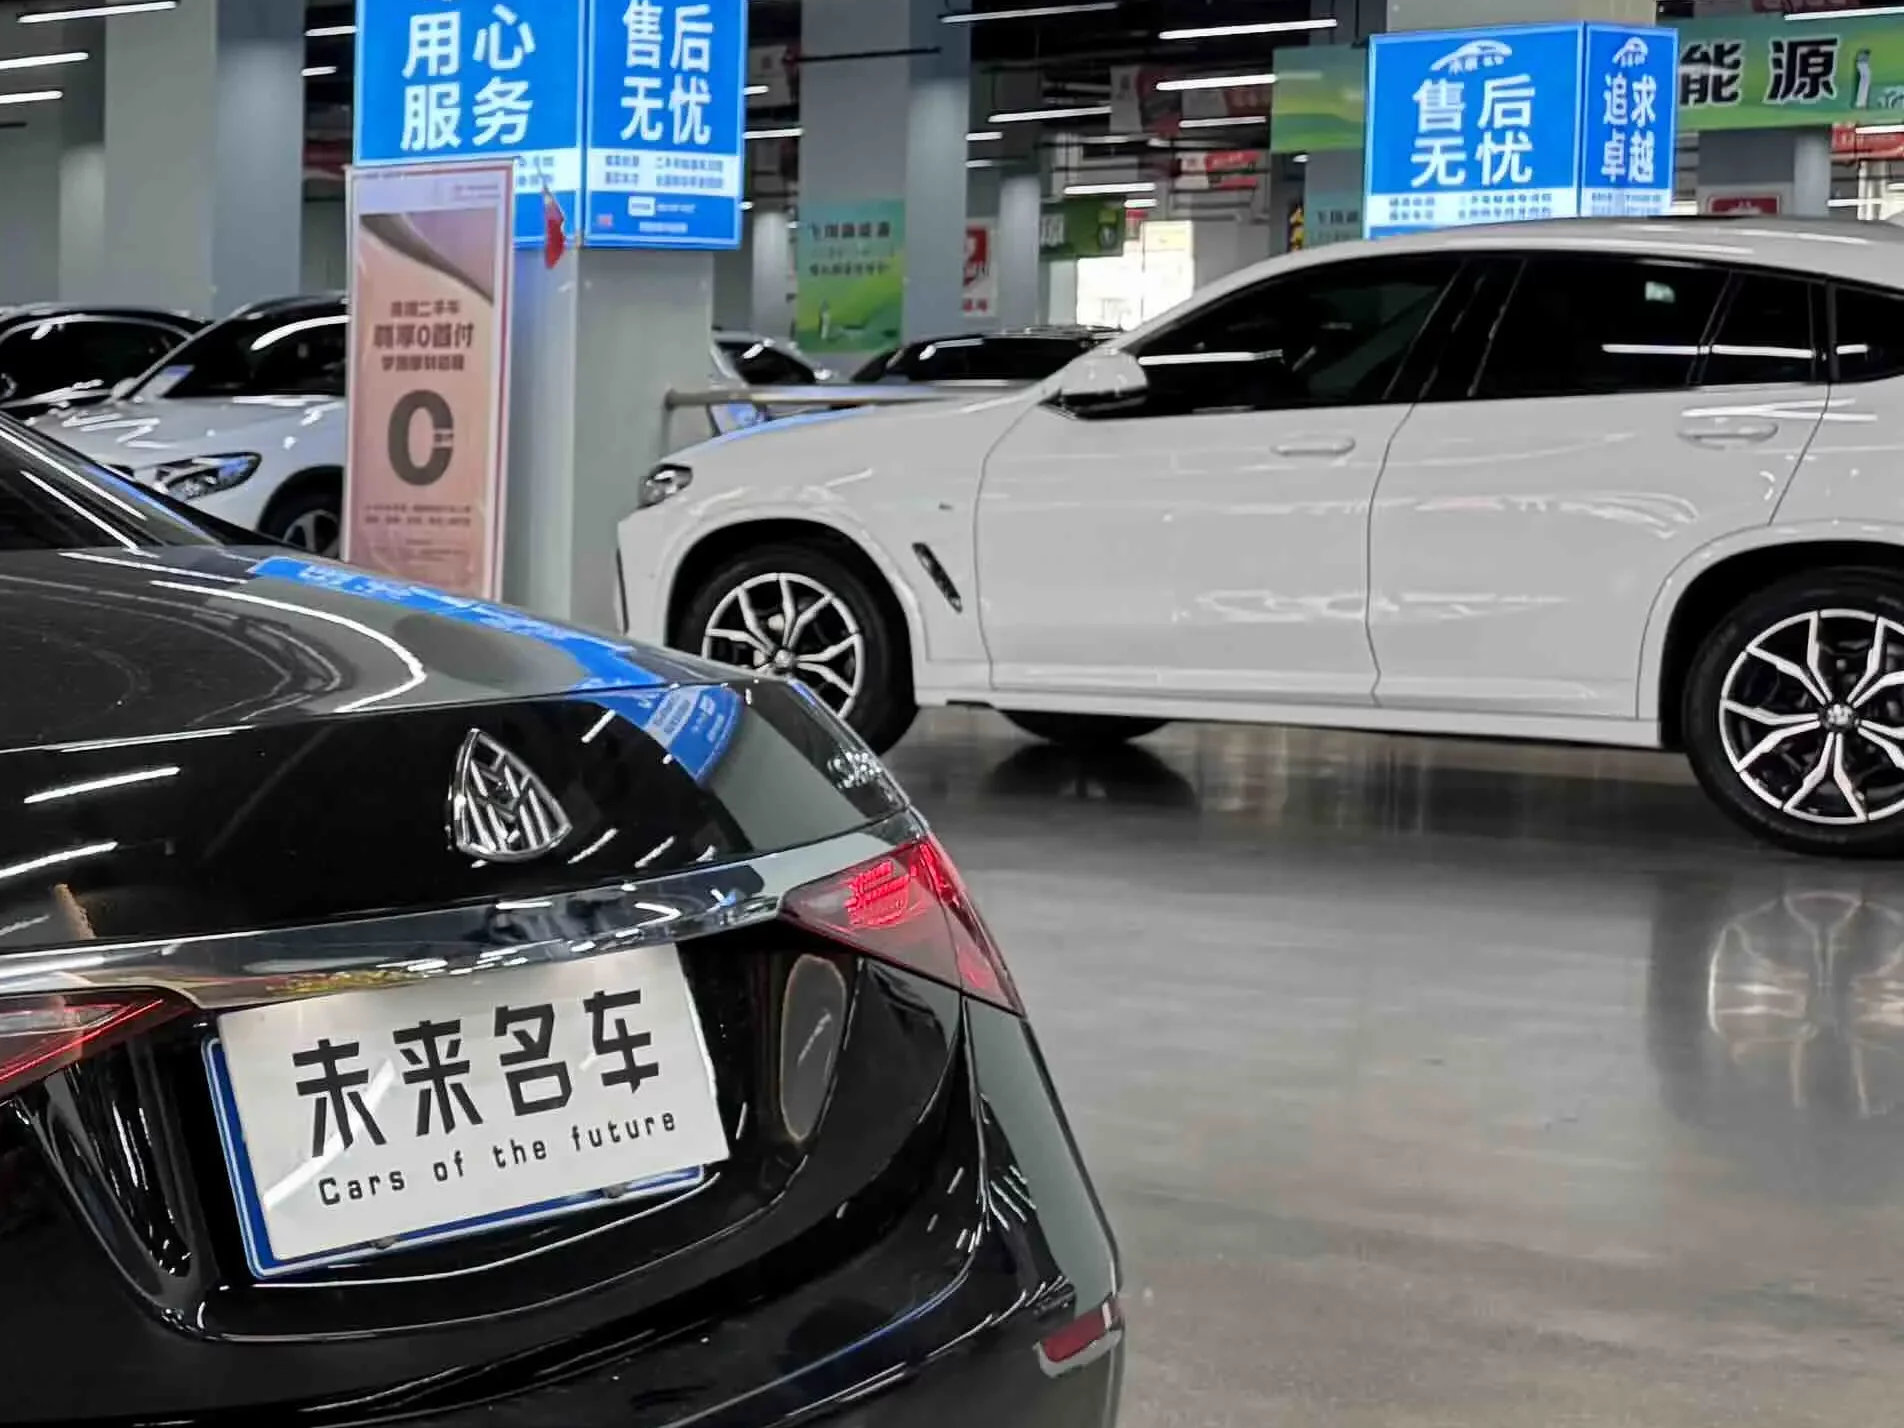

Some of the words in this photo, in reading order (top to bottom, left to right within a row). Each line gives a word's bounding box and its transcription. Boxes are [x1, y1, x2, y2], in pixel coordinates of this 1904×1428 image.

[402, 4, 536, 79] 用心
[1679, 36, 1840, 107] 能源
[400, 76, 536, 152] 服务
[620, 74, 713, 146] 无忧
[1412, 74, 1537, 134] 售后
[1602, 73, 1658, 127] 追求
[1410, 132, 1535, 188] 无忧
[1600, 130, 1656, 184] 卓越
[291, 988, 660, 1158] 未来名车
[319, 1169, 406, 1206] Cars
[433, 1150, 465, 1183] of
[493, 1137, 547, 1169] the
[571, 1110, 677, 1153] future
